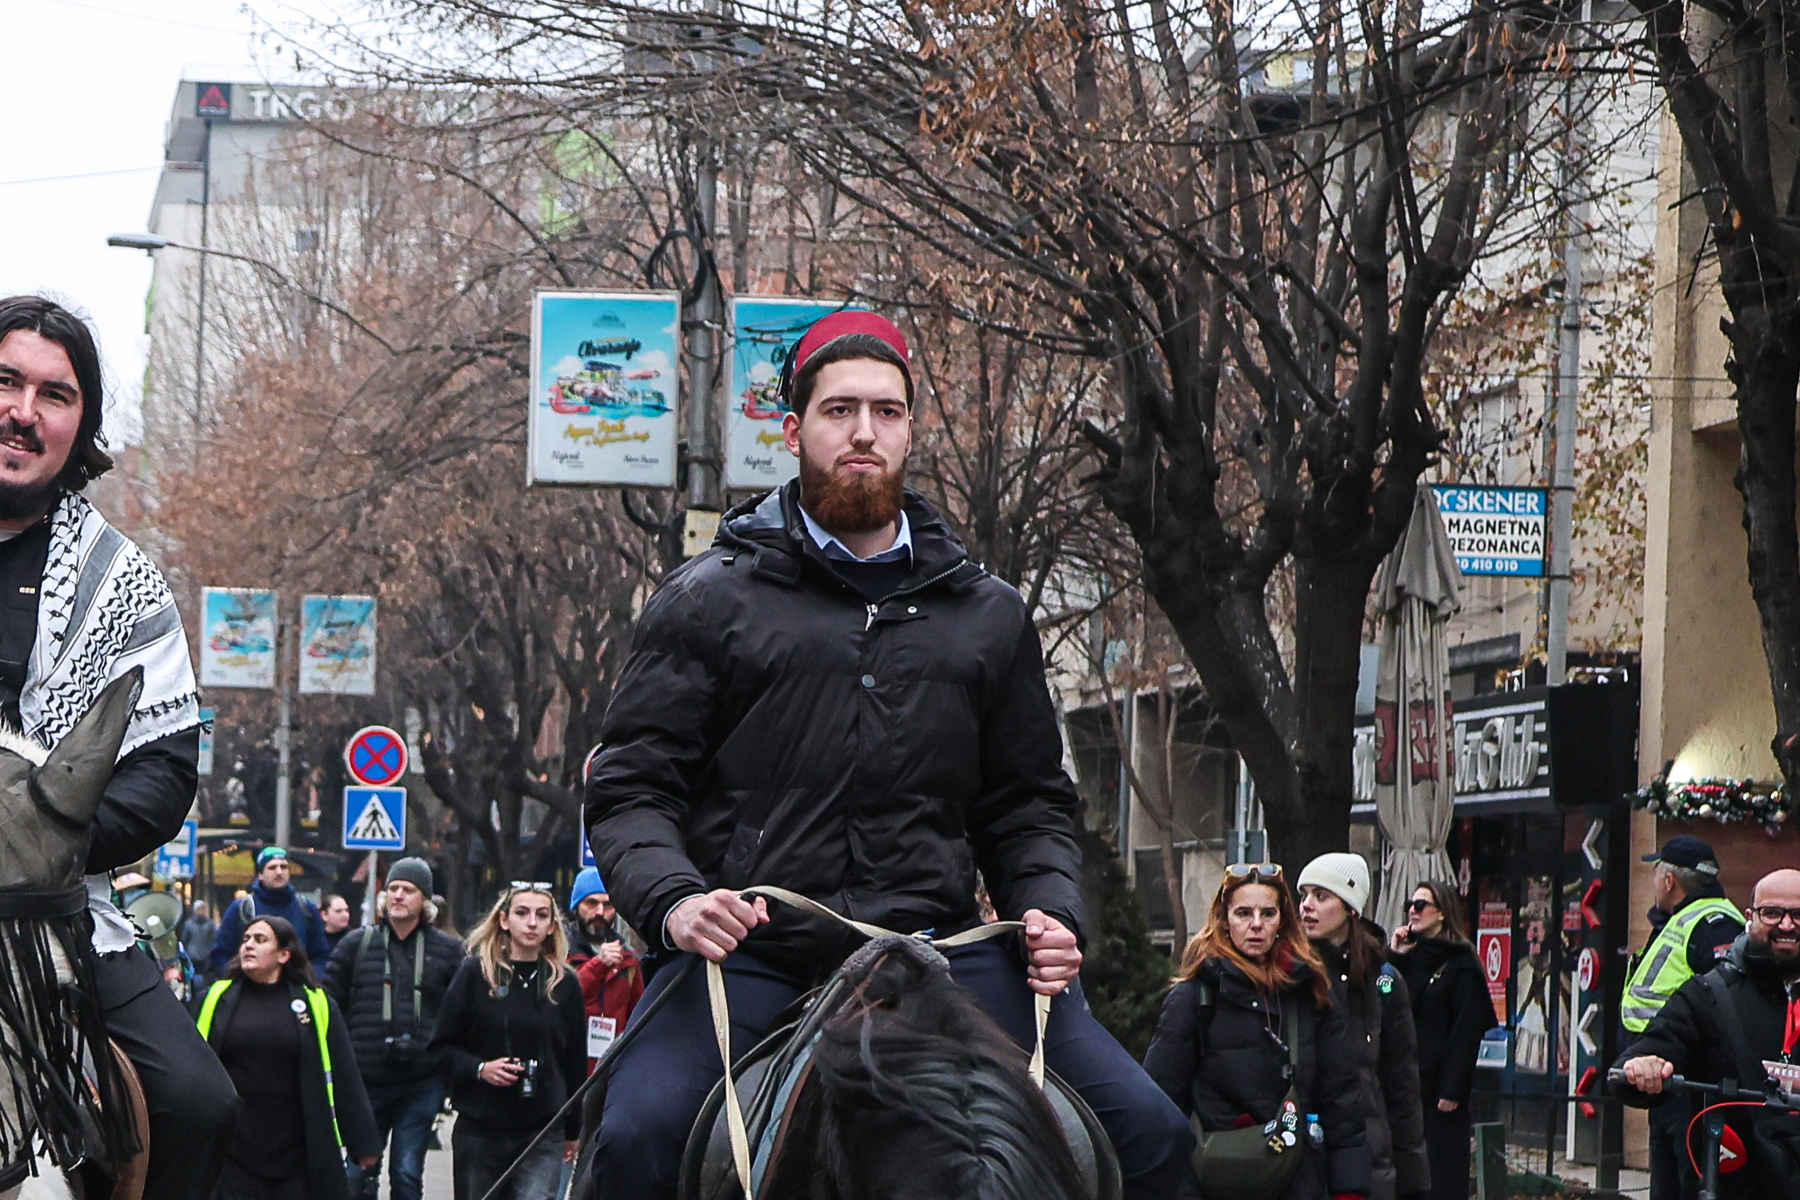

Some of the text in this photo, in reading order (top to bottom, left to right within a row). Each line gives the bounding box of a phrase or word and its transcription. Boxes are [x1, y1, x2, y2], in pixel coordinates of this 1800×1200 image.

[1455, 488, 1540, 514] SKENER
[1447, 518, 1542, 536] MAGNETNA
[1471, 559, 1493, 572] 410
[1495, 560, 1519, 573] 010
[1767, 1066, 1800, 1079] PRESS
